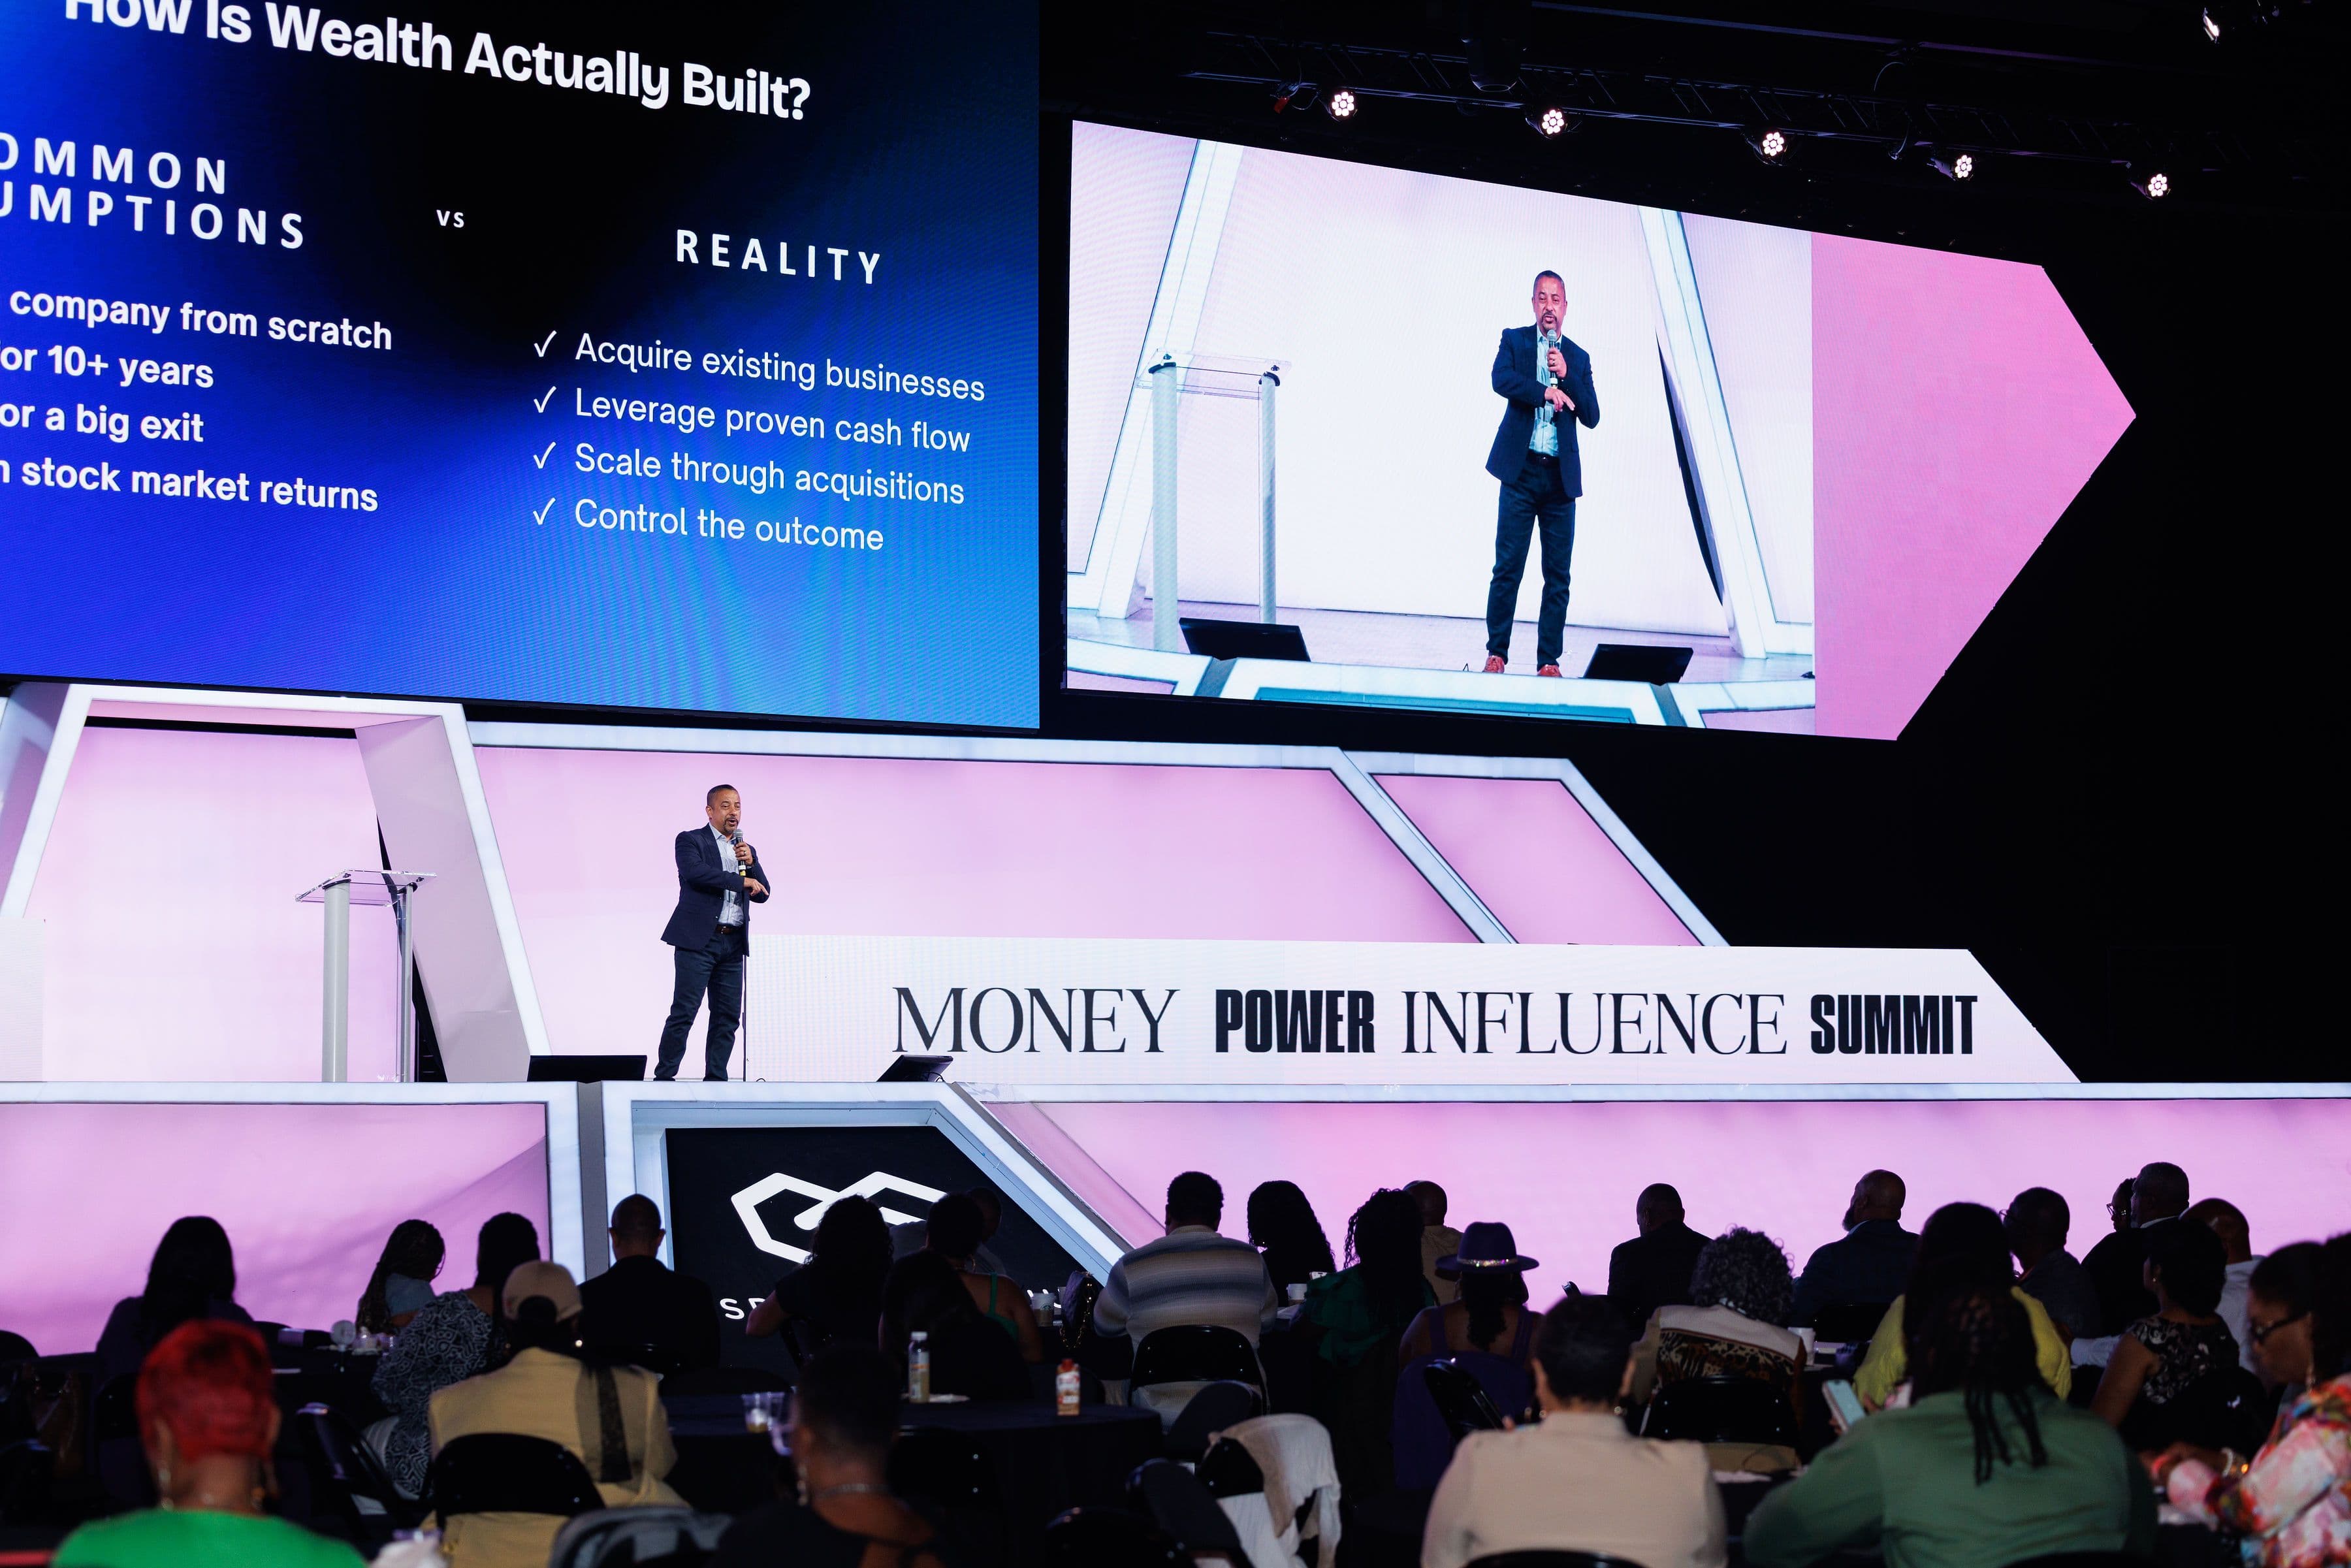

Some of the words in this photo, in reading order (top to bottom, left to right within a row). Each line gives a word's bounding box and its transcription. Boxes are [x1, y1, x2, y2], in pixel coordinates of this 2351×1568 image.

[206, 0, 251, 43] Is
[264, 2, 452, 71] Wealth
[464, 32, 669, 110] Actually
[684, 62, 810, 120] Built?
[677, 229, 880, 285] REALITY
[10, 291, 170, 334] company
[180, 302, 257, 337] from
[268, 317, 392, 350] scratch
[0, 339, 38, 372] or
[48, 345, 108, 376] 10+
[119, 358, 214, 388] years
[575, 332, 692, 373] Acquire
[702, 348, 815, 391] existing
[826, 359, 985, 401] businesses
[45, 408, 65, 431] a
[76, 403, 129, 443] big
[140, 412, 204, 442] exit
[575, 387, 715, 434] Leverage
[726, 409, 825, 438] proven
[835, 418, 901, 446] cash
[911, 421, 970, 452] flow
[22, 457, 121, 492] stock
[132, 470, 249, 502] market
[261, 477, 378, 512] returns
[575, 443, 661, 477] Scale
[671, 452, 784, 494] through
[795, 468, 965, 504] acquisitions
[575, 498, 688, 536] Control
[697, 509, 745, 539] the
[756, 517, 884, 551] outcome
[892, 987, 1179, 1053] MONEY
[1215, 989, 1375, 1053] POWER
[1401, 991, 1787, 1055] INFLUENCE
[1810, 994, 1978, 1055] SUMMIT
